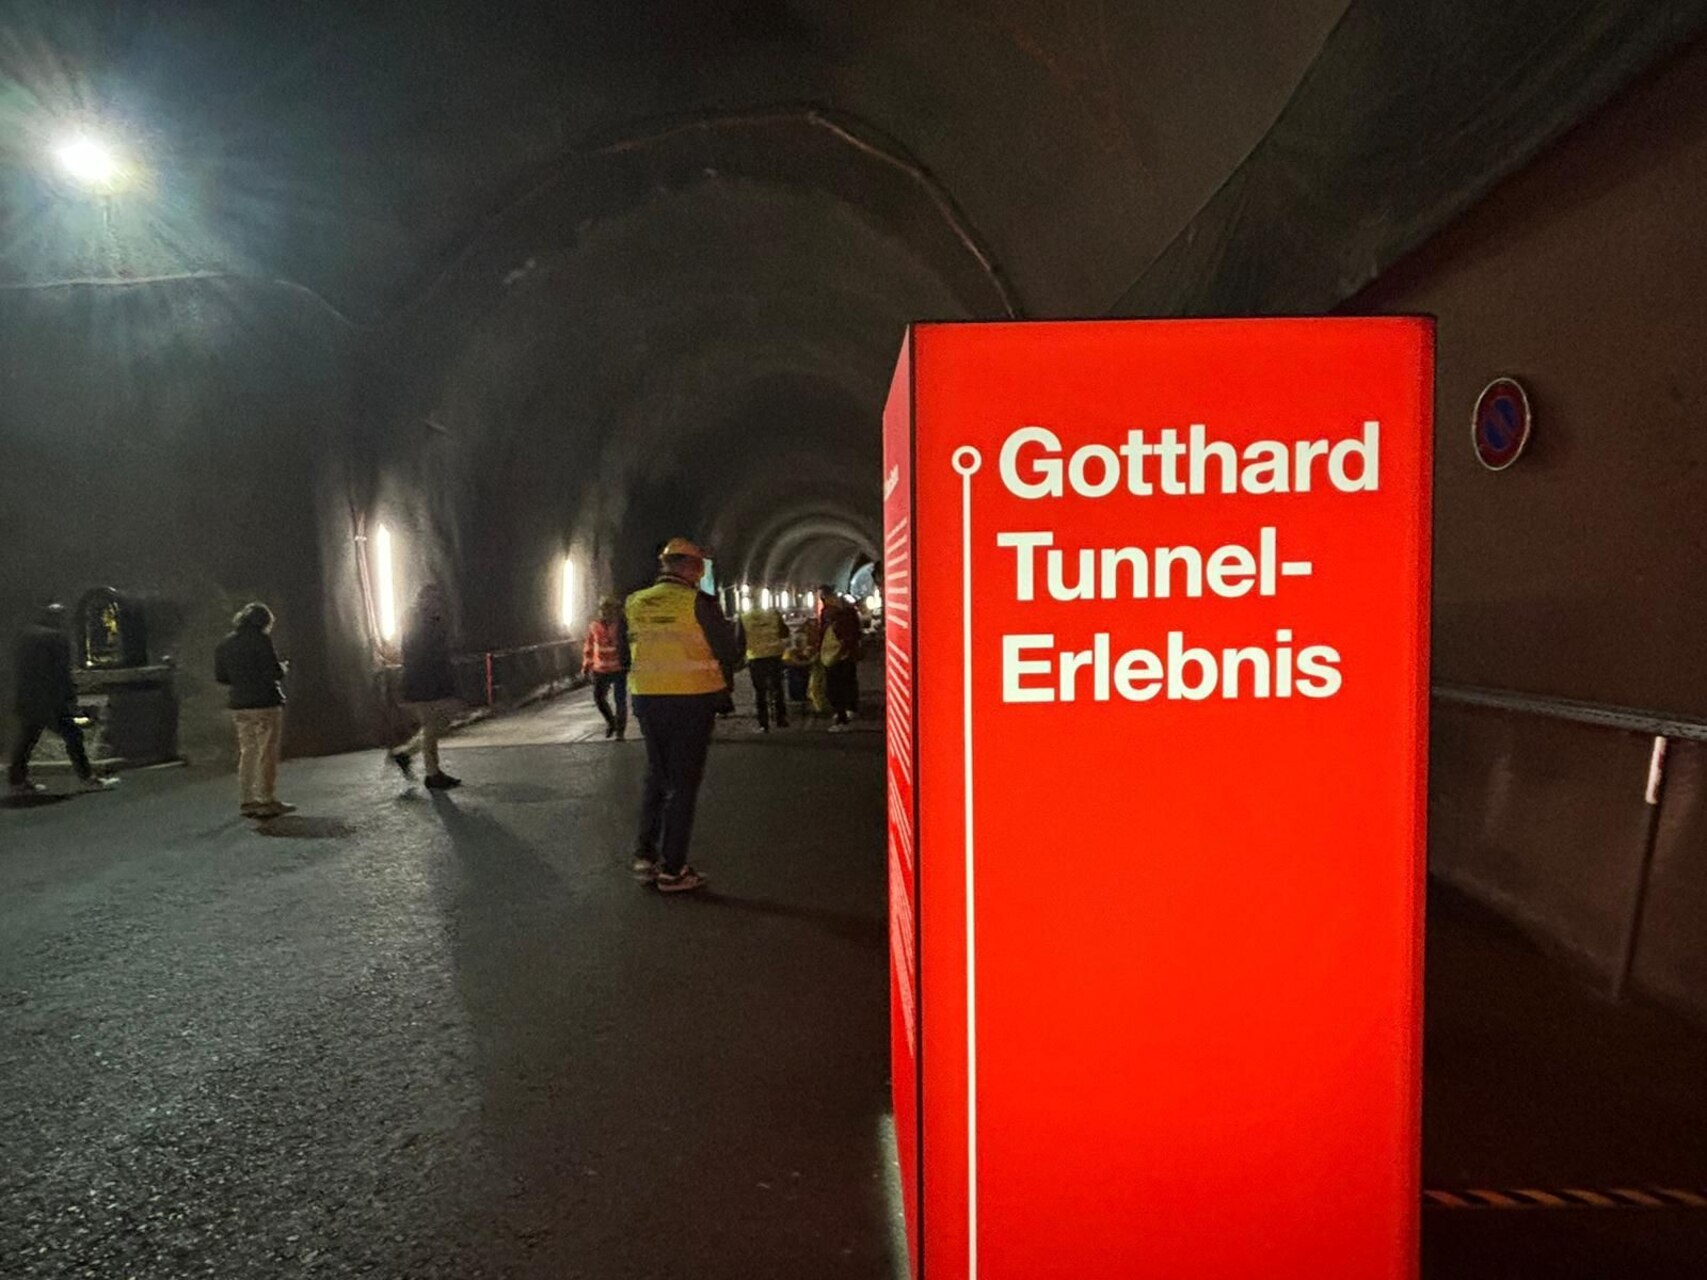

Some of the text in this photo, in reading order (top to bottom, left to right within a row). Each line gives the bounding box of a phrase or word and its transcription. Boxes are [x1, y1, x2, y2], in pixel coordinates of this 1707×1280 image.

[999, 421, 1380, 500] Gotthard
[997, 527, 1312, 602] Tunnel-
[1002, 629, 1342, 703] Erlebnis
